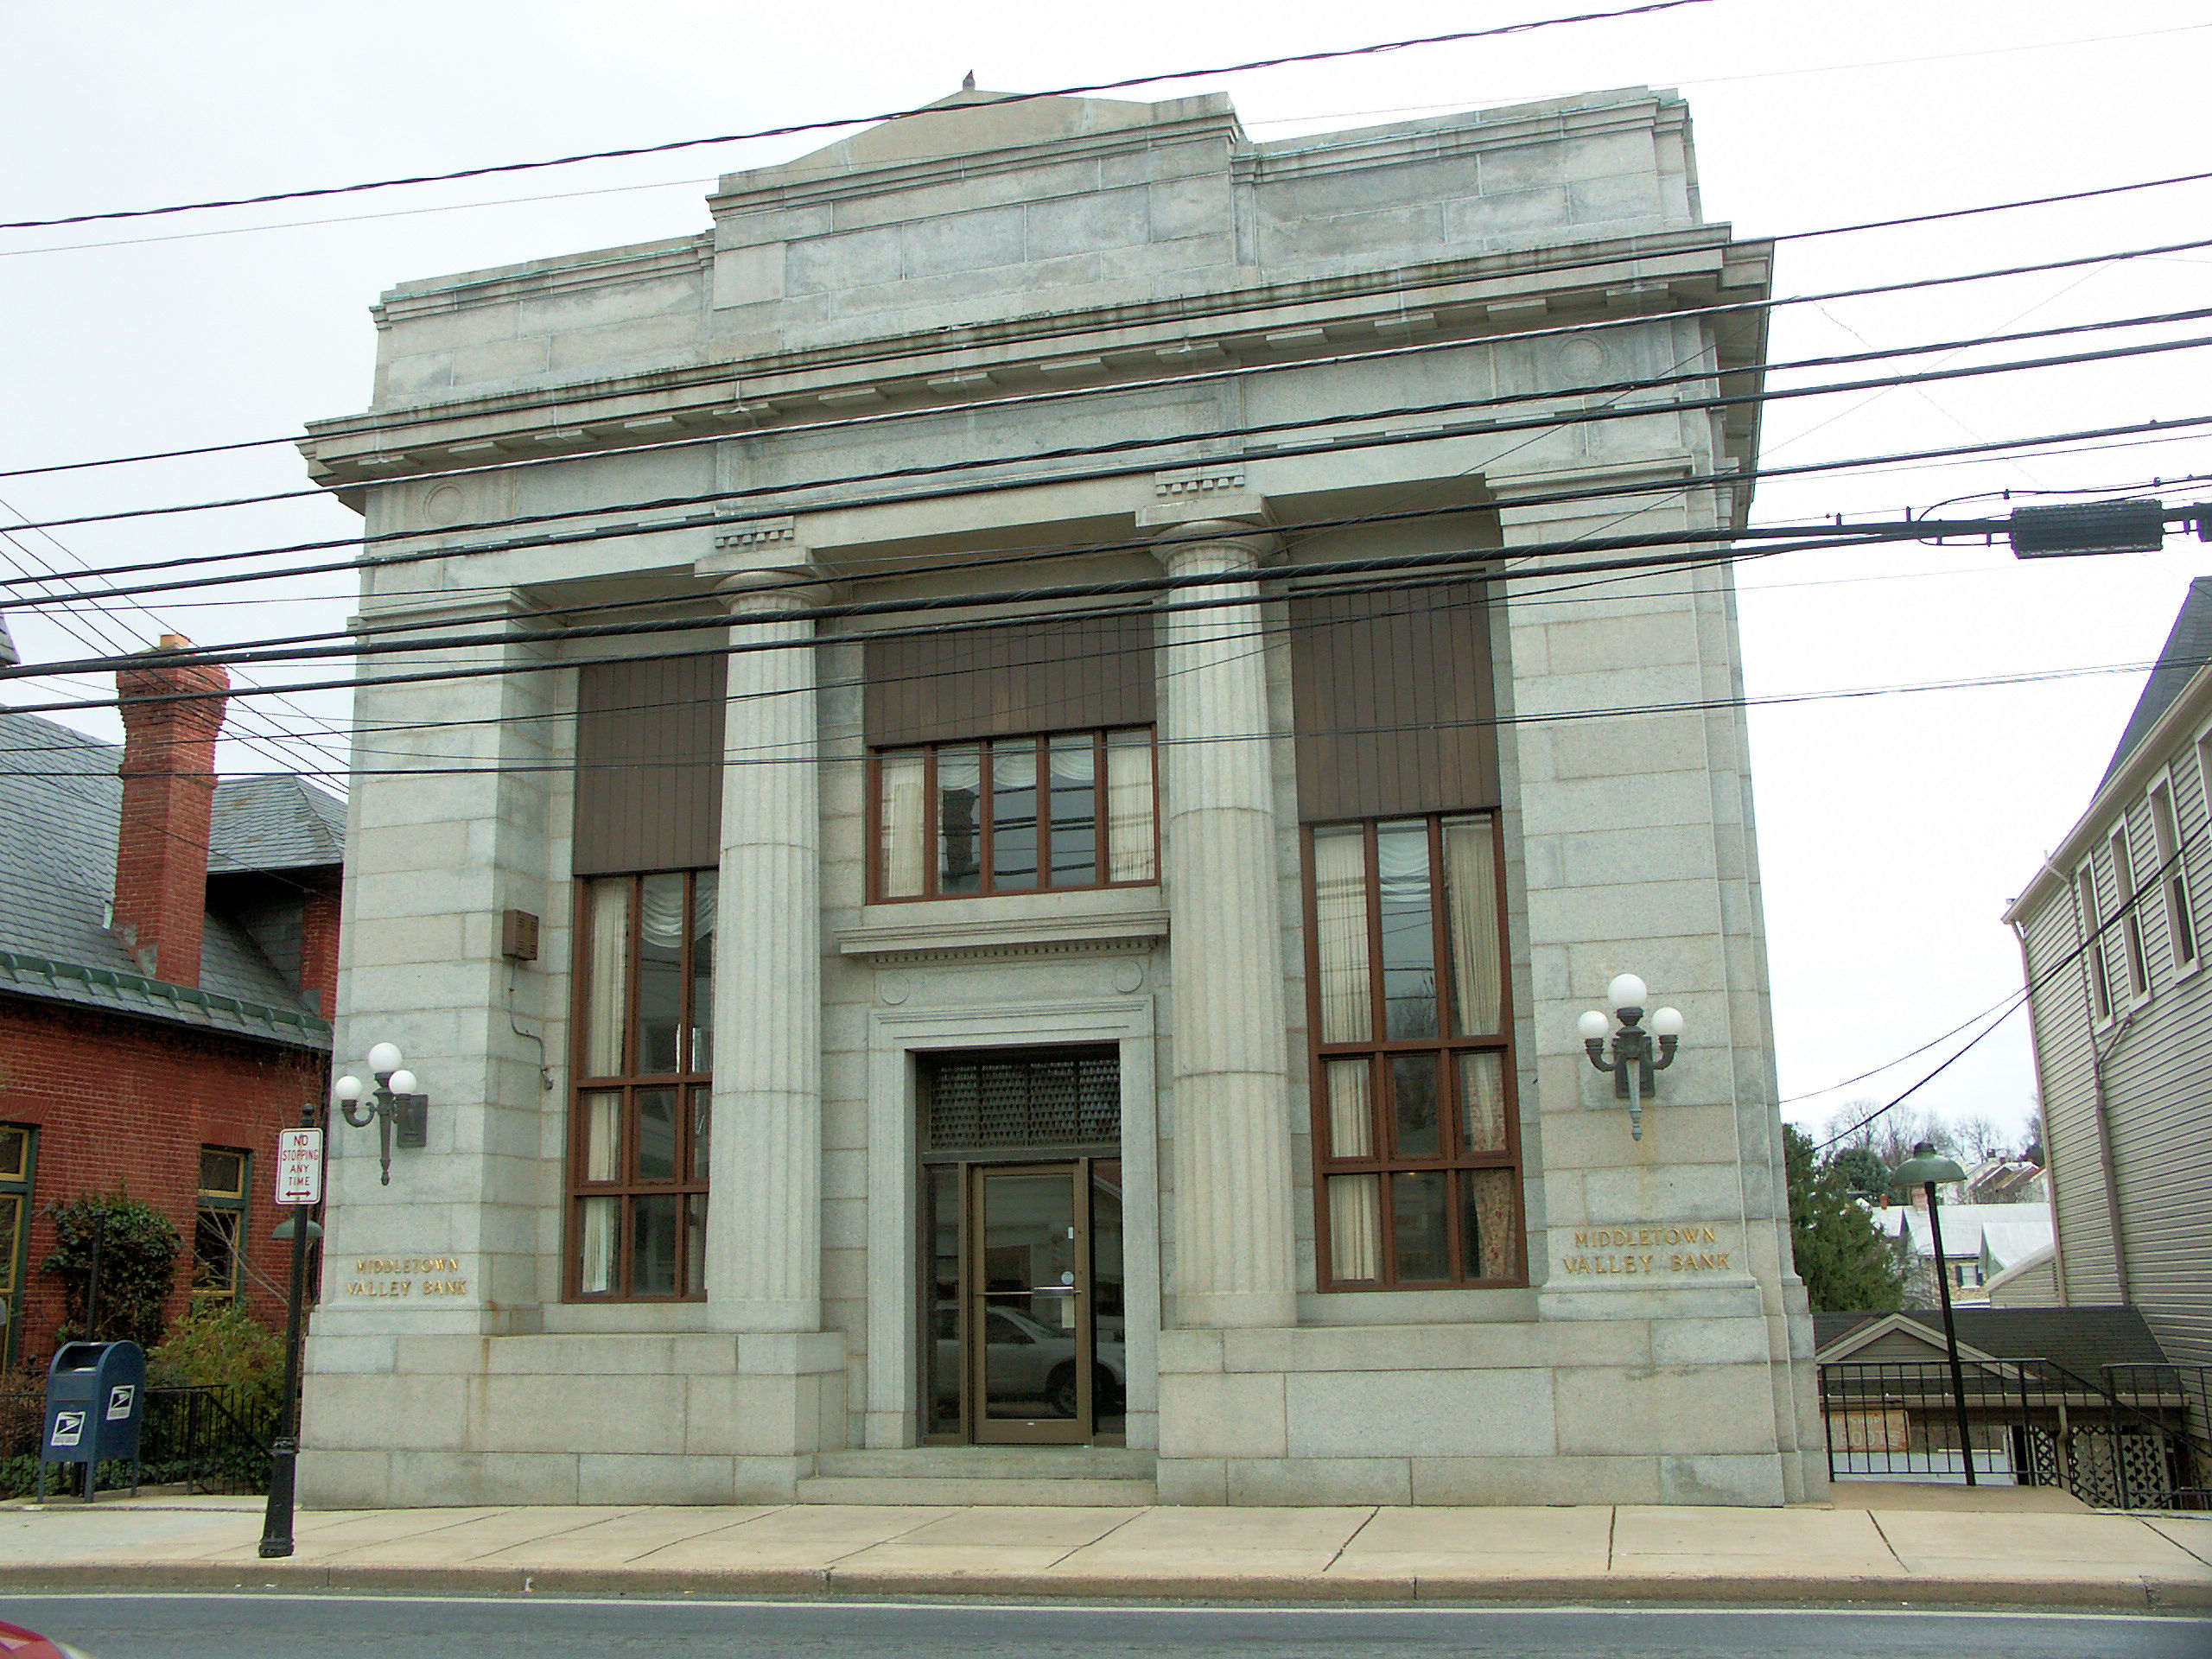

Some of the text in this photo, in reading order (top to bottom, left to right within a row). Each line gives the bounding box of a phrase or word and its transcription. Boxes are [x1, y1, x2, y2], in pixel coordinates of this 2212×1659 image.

[294, 1135, 309, 1147] NO
[283, 1149, 320, 1160] STOPPING
[290, 1164, 309, 1173] ANY
[289, 1176, 310, 1186] TIME
[1575, 1227, 1716, 1247] MIDDLETOWN
[356, 1258, 459, 1274] MIDDLETOWN
[1563, 1252, 1732, 1274] VALLEY BANK
[346, 1280, 467, 1296] VALLEY BANK
